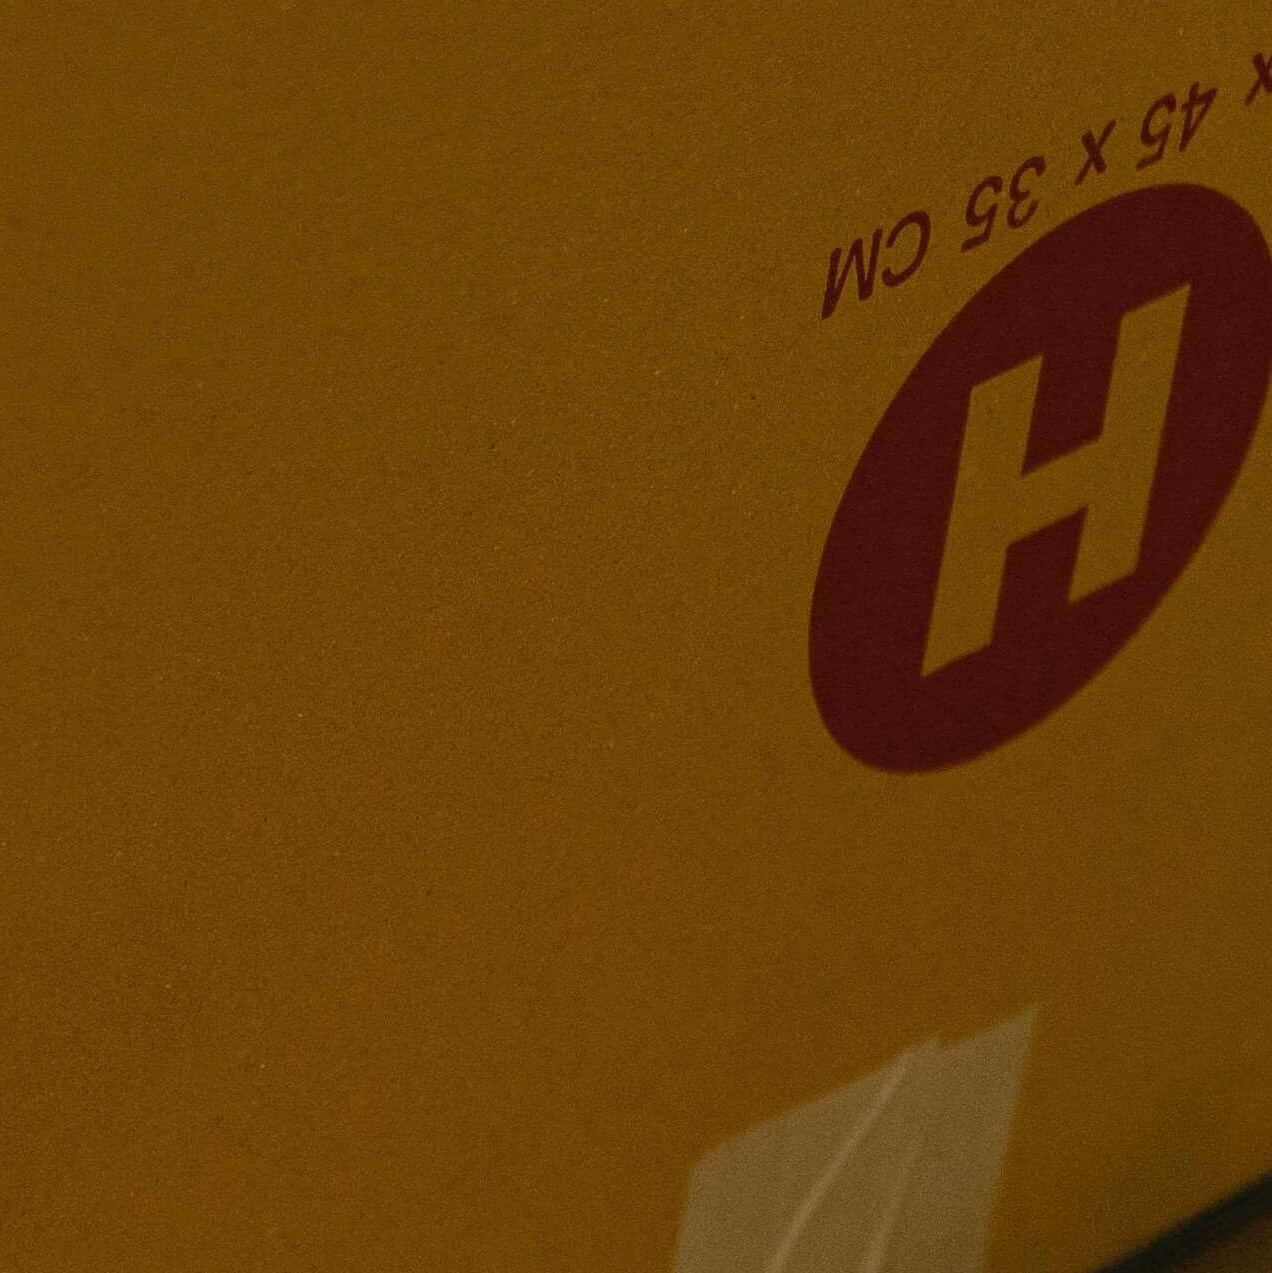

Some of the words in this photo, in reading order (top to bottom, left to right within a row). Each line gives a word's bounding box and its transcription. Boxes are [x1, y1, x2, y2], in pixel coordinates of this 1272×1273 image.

[1074, 119, 1117, 186] x
[1136, 81, 1218, 170] 45
[960, 155, 1047, 252] 35
[820, 209, 932, 321] CM
[919, 281, 1192, 680] H
